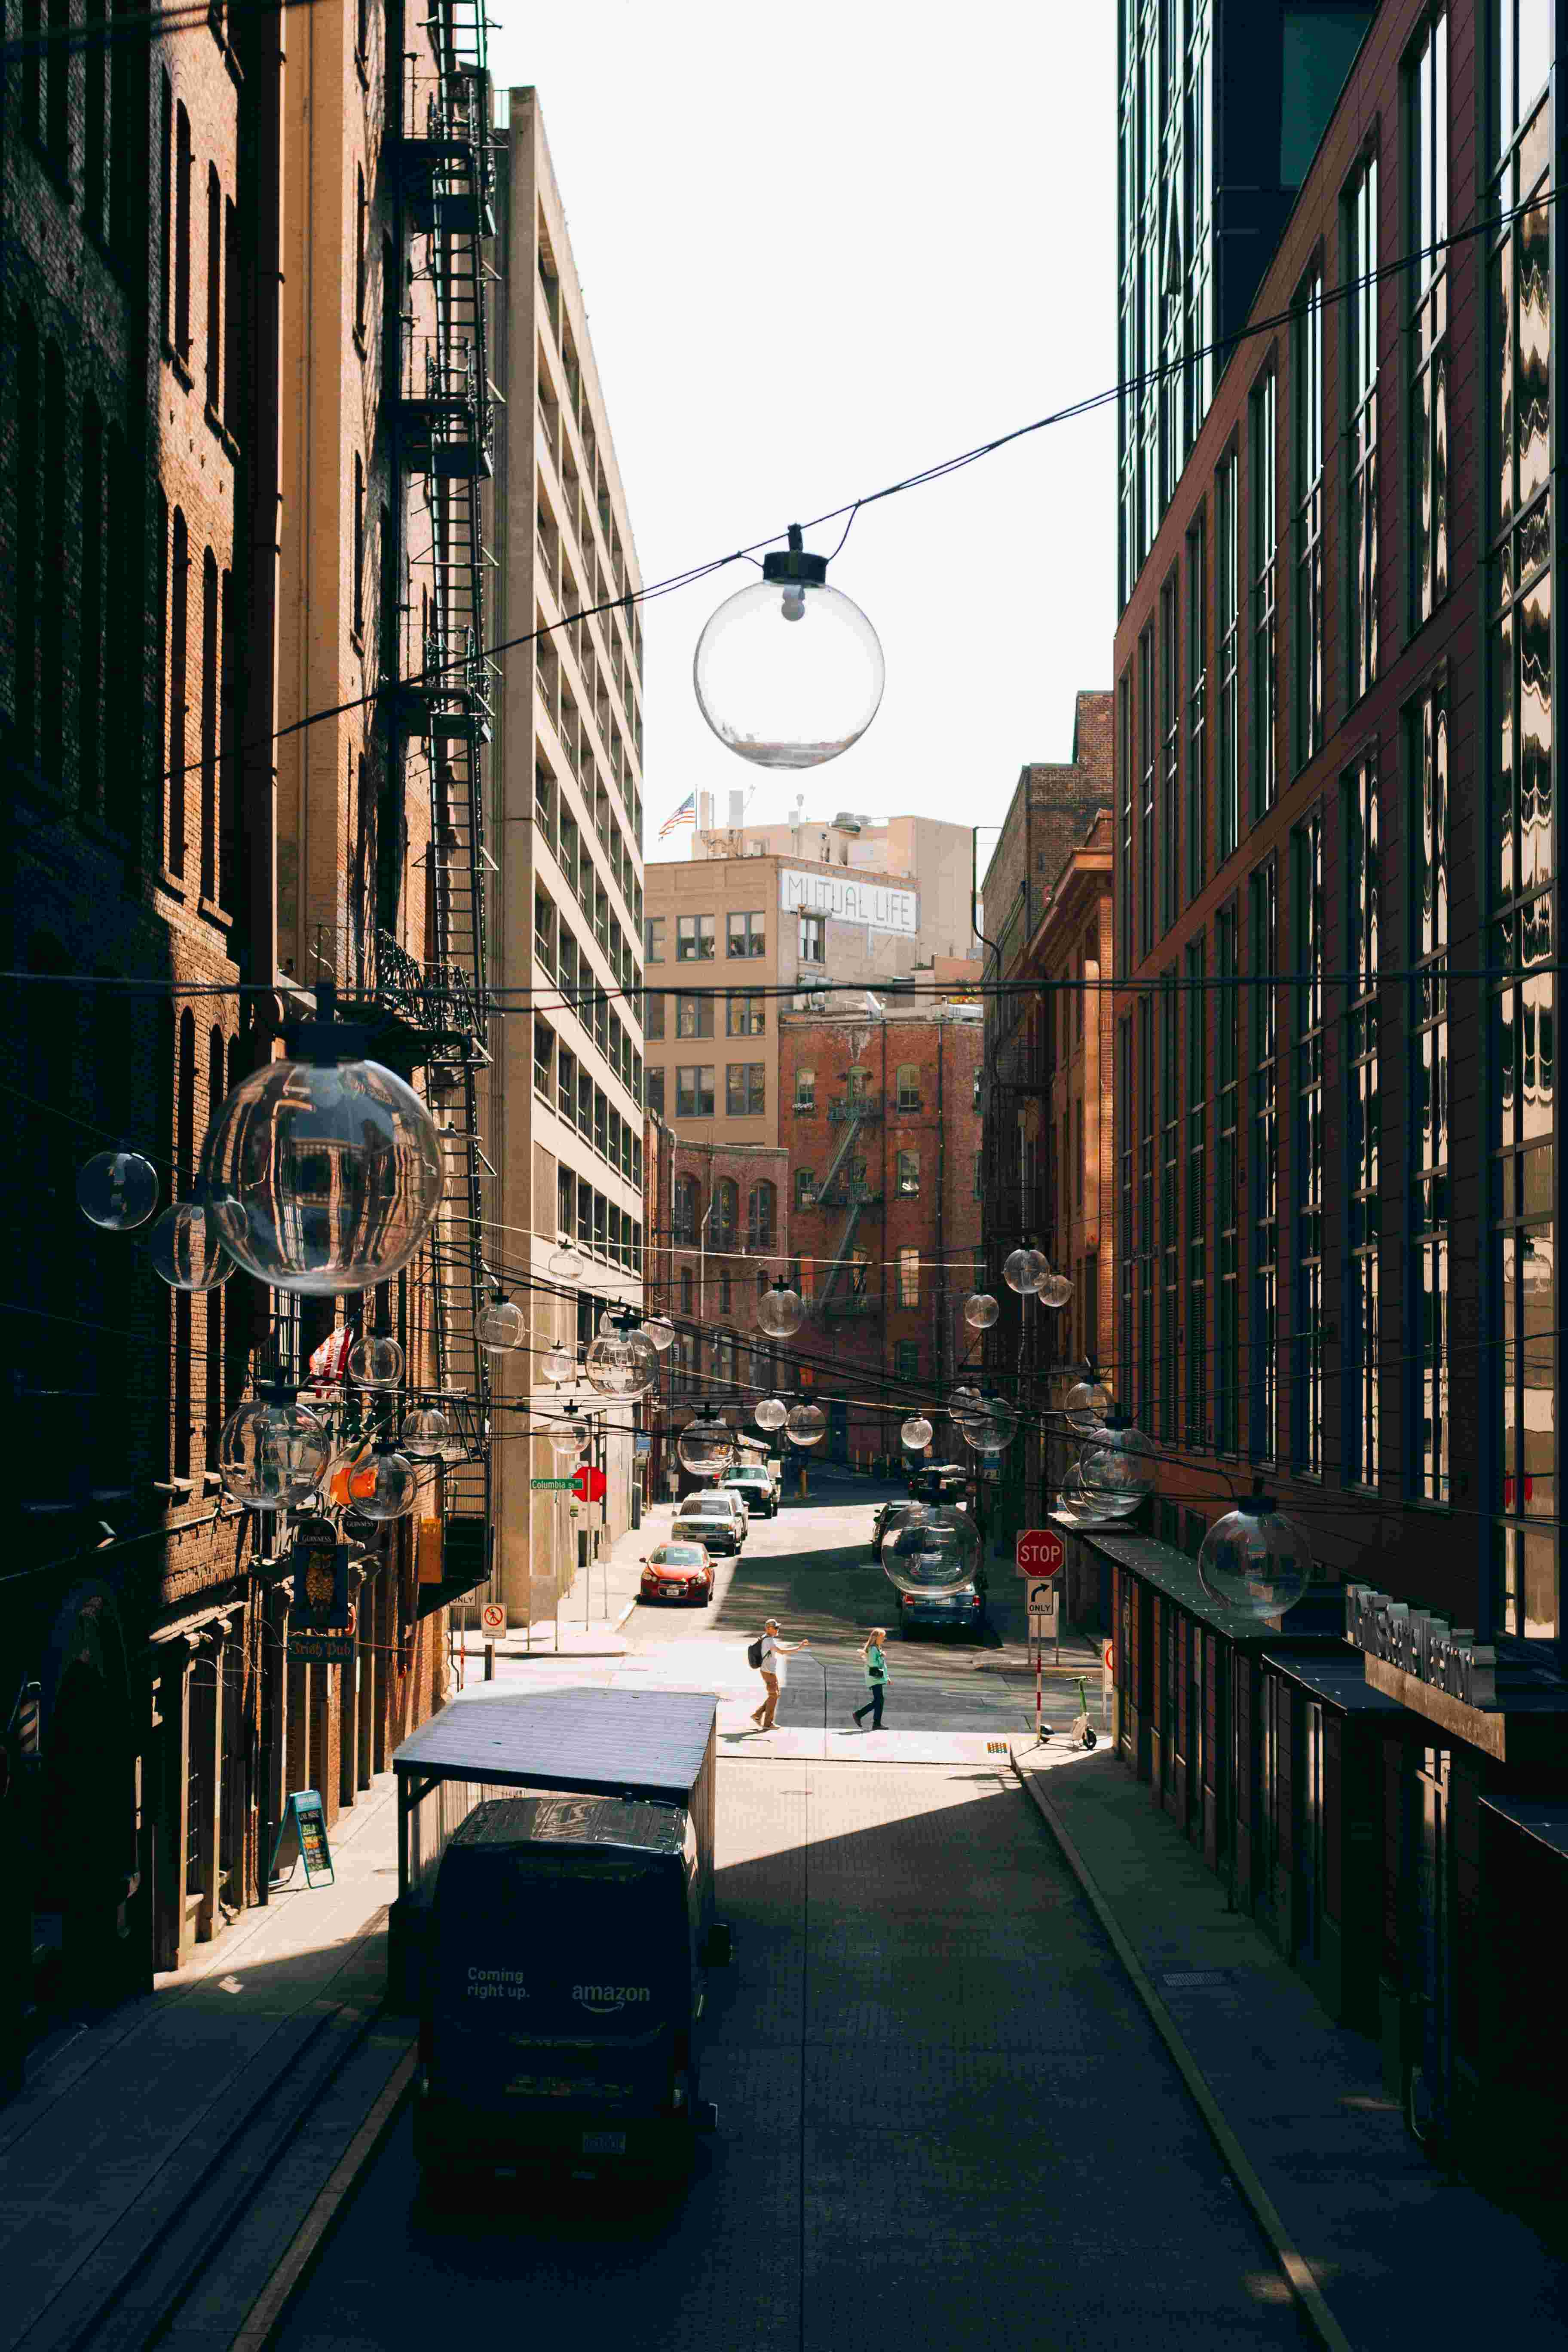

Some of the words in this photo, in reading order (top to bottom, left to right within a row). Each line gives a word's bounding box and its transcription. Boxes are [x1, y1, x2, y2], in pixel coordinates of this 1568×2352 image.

[789, 874, 868, 919] MUTUAL
[876, 890, 910, 925] LIFE
[532, 1480, 565, 1489] Columbia
[1021, 1545, 1060, 1562] STOP
[289, 1640, 323, 1658] Irish
[325, 1639, 351, 1656] Pub
[467, 1966, 523, 1984] Coming
[467, 1982, 505, 2000] right
[508, 1985, 530, 2002] up.
[571, 1984, 650, 2002] amazon
